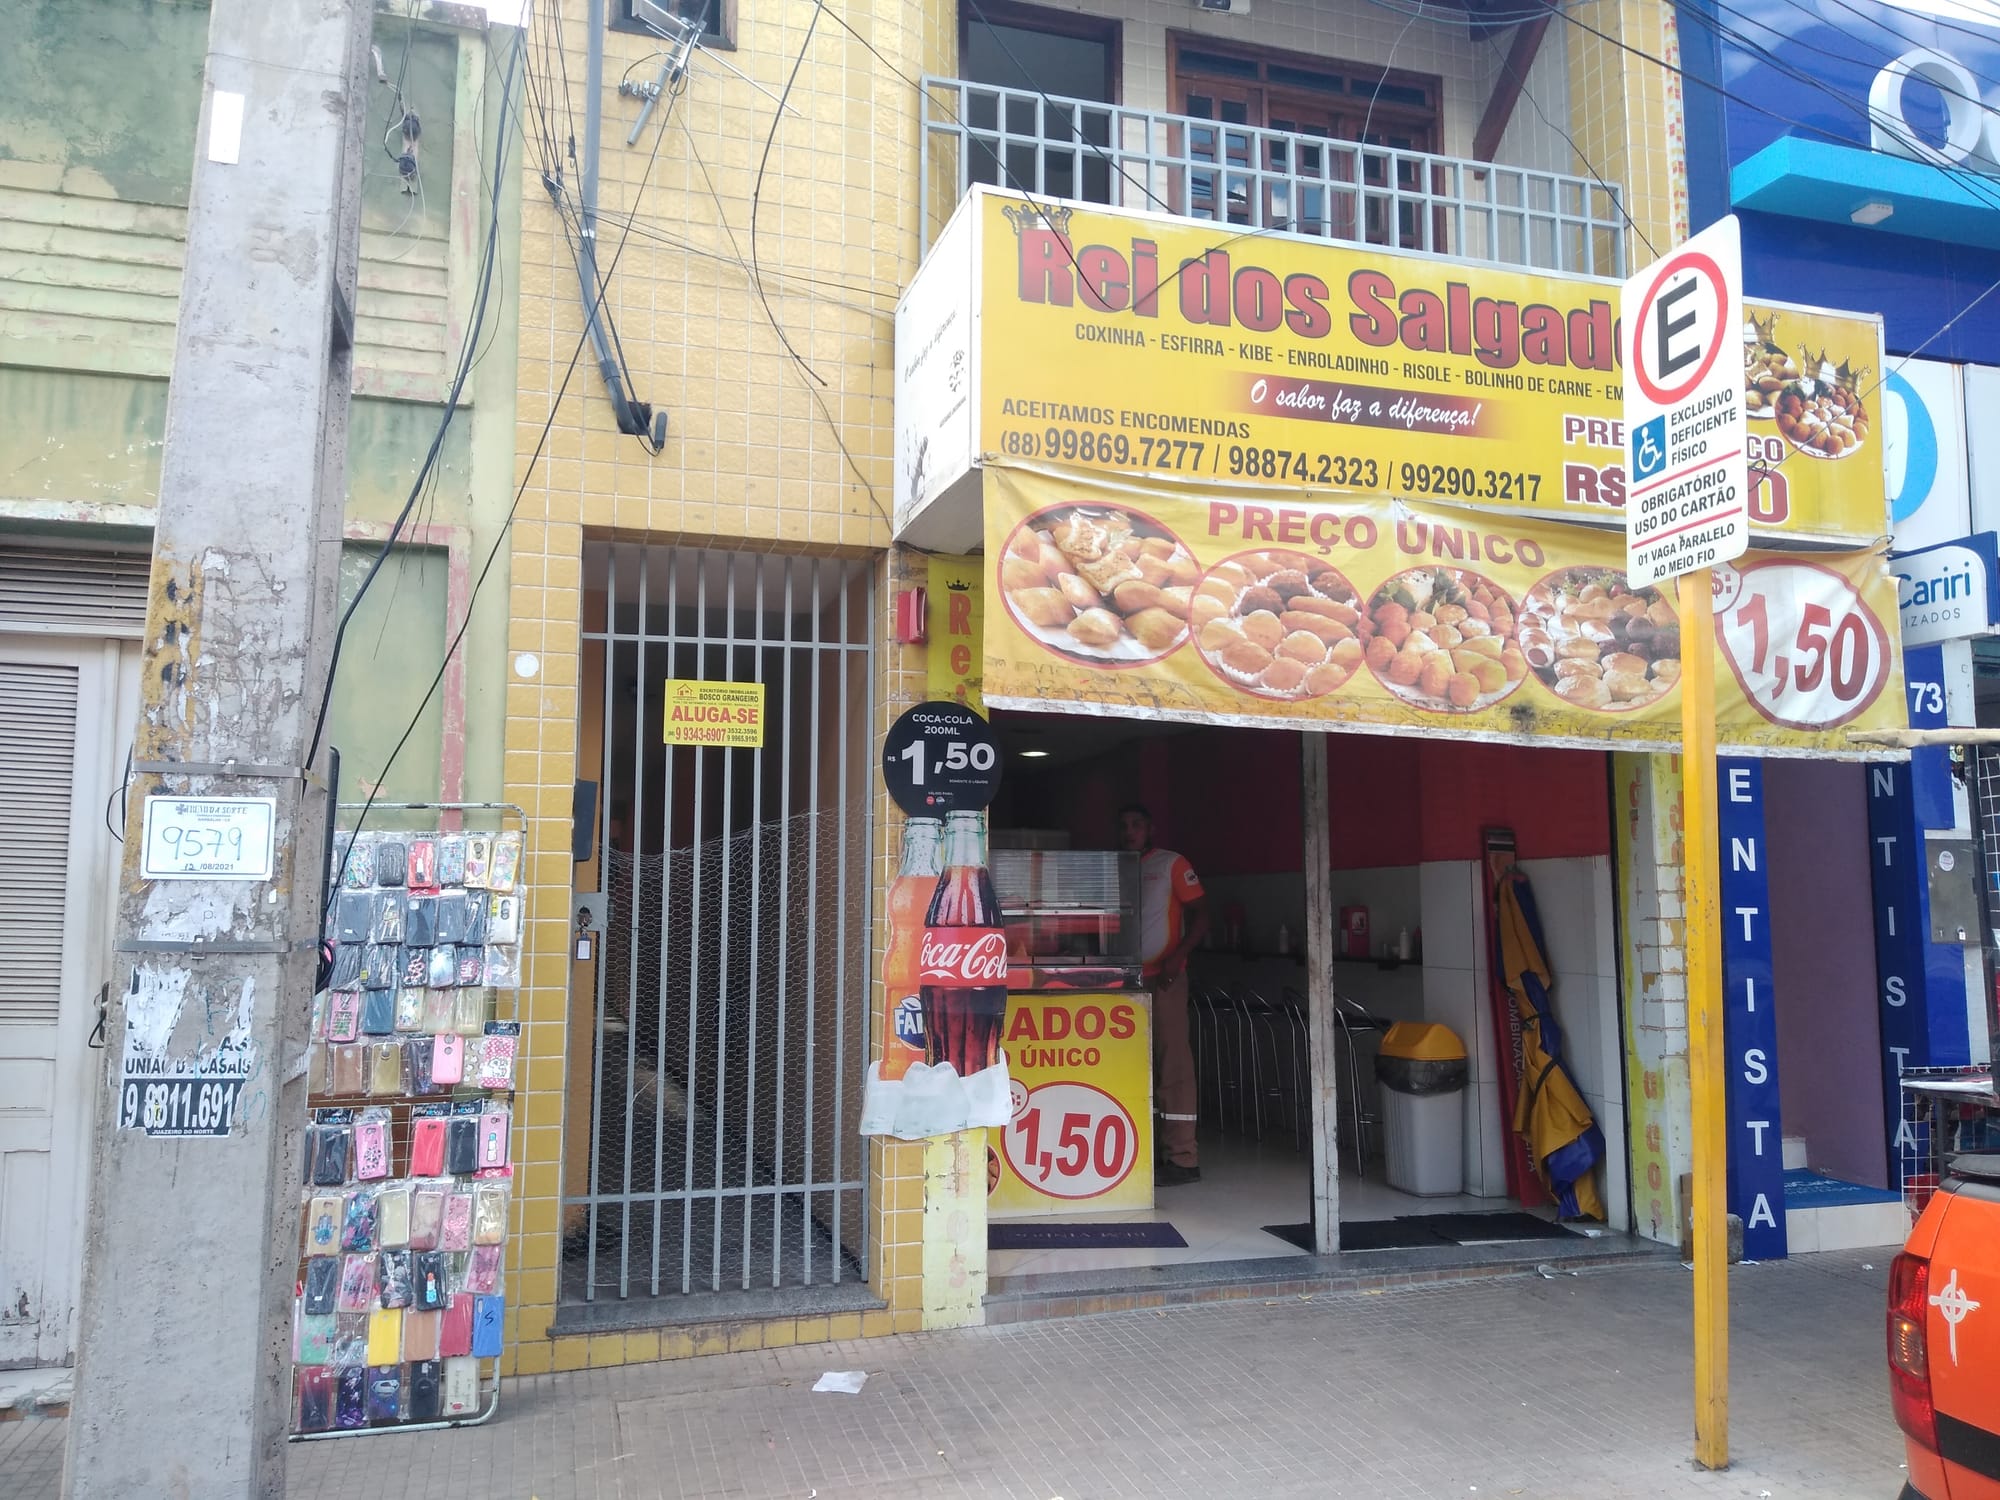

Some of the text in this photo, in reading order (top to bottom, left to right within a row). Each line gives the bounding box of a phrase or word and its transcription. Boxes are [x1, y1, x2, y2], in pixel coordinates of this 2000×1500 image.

[1018, 226, 1623, 372] Rei dos Salgad
[1658, 279, 1699, 379] E
[1075, 323, 1145, 348] COXINHA
[1160, 334, 1225, 357] ESFIRRA
[1239, 342, 1273, 363] KIBE
[1288, 349, 1389, 376] ENROLADINHO
[1403, 363, 1451, 382] RISOLE
[1465, 370, 1524, 391] BOLINHO
[1527, 377, 1545, 393] DE
[1549, 379, 1592, 398] CARNE
[1002, 398, 1250, 439] ACEITAMOS ENCOMENDAS
[1251, 379, 1482, 431] O sabor faz a diferença!
[1671, 388, 1733, 426] EXCLUSIVO
[1671, 407, 1737, 446] DEFICIENTE
[1229, 445, 1378, 487] 98874.2323
[1401, 462, 1541, 502] 99290.3217
[1671, 440, 1707, 466] FÍSICO
[1565, 464, 1626, 507] R$
[1641, 468, 1726, 514] OBRIGATÓRIO
[1635, 486, 1736, 536] USO DO CARTÃO
[1208, 500, 1545, 568] PREÇO ÚNICO
[1638, 522, 1735, 567] 01 VAGA PARALELO
[1653, 547, 1715, 580] AO MEIO FIO
[1899, 561, 1970, 611] Cariri
[1902, 607, 1962, 629] IZADOS
[1736, 593, 1869, 702] 1,50
[671, 705, 759, 725] ALUGA-SE
[699, 693, 721, 701] BOSCO
[722, 694, 759, 703] GRANGEIRO
[912, 713, 973, 724] COCA-COLA
[1909, 682, 1943, 714] 73
[675, 727, 681, 740] 9
[683, 727, 726, 742] 9343-6907
[924, 726, 960, 735] 200ML
[163, 826, 242, 861] 9579
[1003, 1005, 1136, 1042] ADOS
[1020, 1044, 1101, 1068] ÚNICO
[125, 1083, 139, 1129] 9
[1016, 1107, 1127, 1183] 1,50
